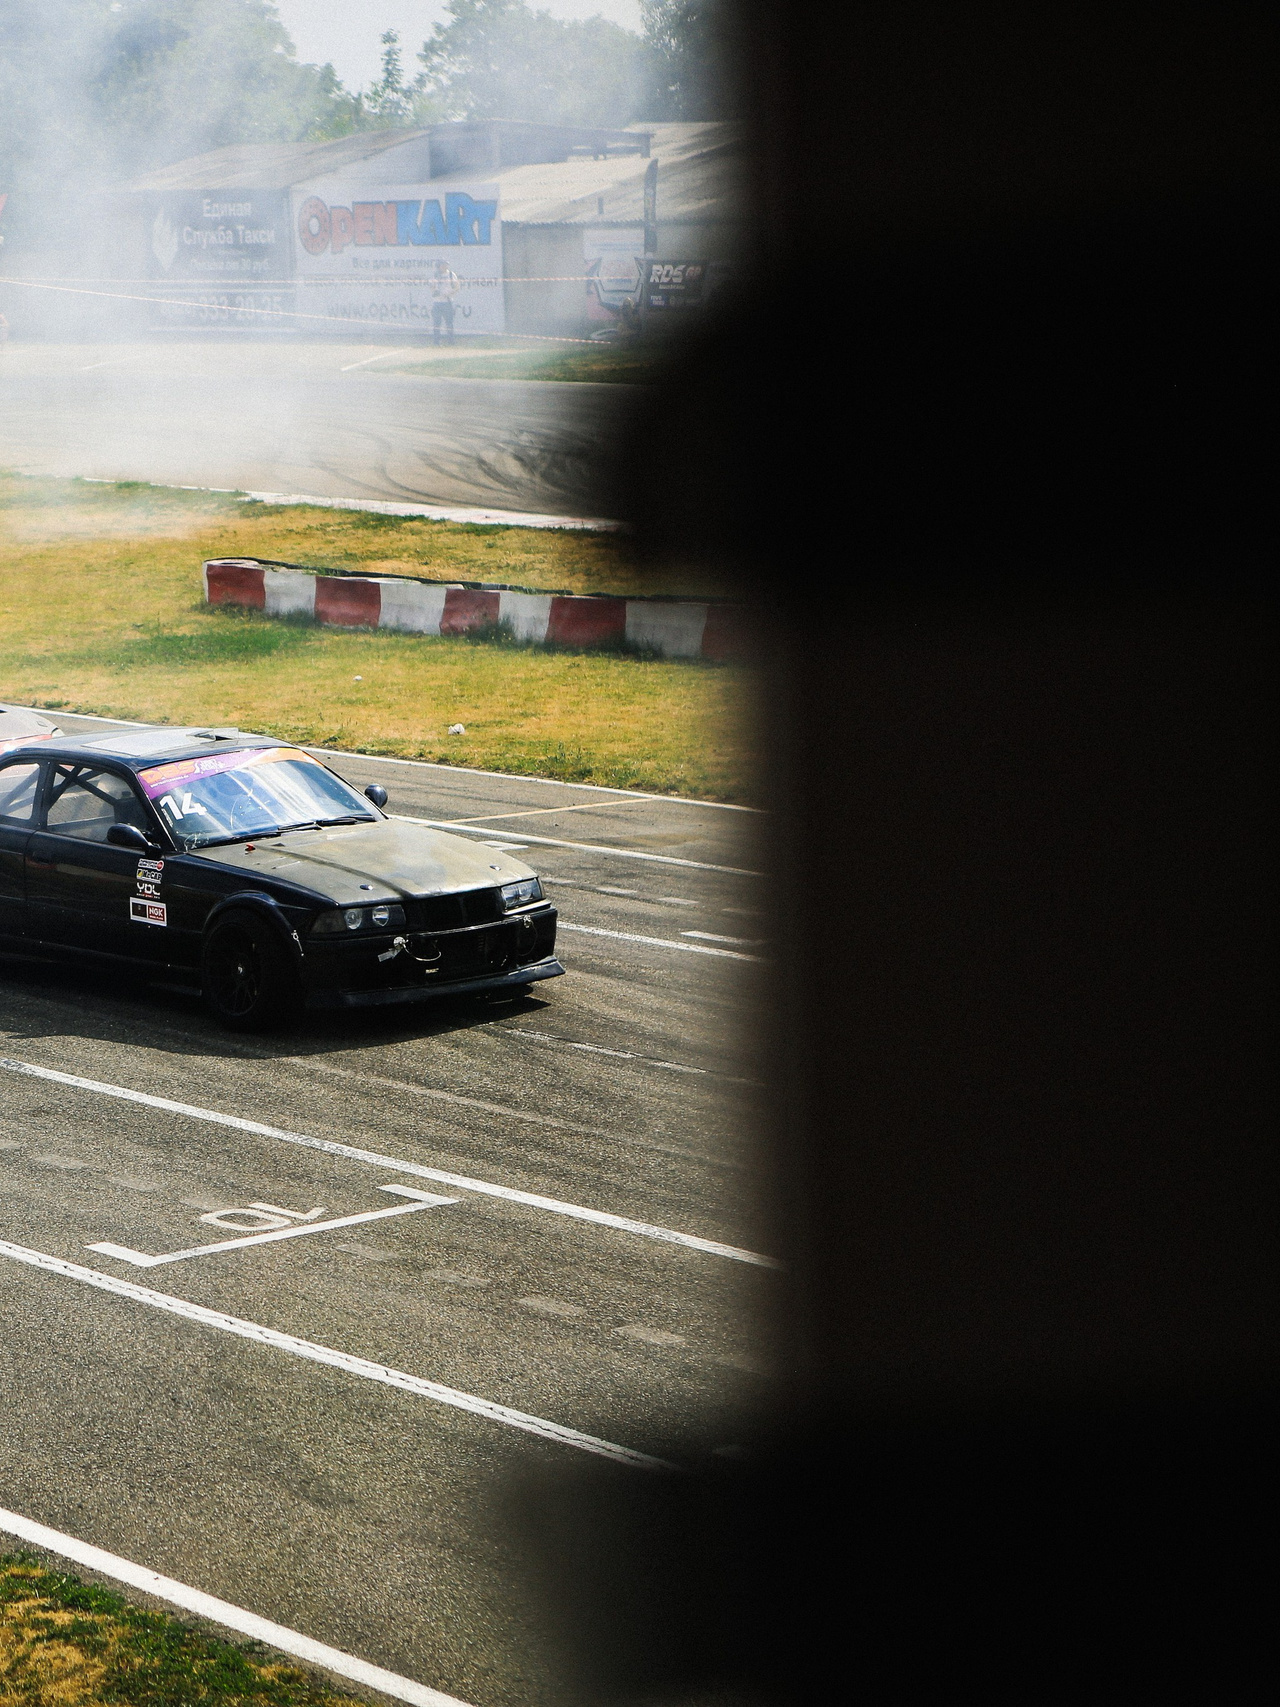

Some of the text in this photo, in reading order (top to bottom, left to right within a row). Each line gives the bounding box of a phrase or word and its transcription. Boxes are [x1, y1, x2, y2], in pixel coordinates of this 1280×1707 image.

[202, 199, 251, 220] Единая
[183, 226, 275, 249] Служба Такси
[650, 264, 687, 283] RDS
[159, 793, 207, 820] 14
[137, 882, 161, 896] YDL
[149, 906, 163, 917] NGK
